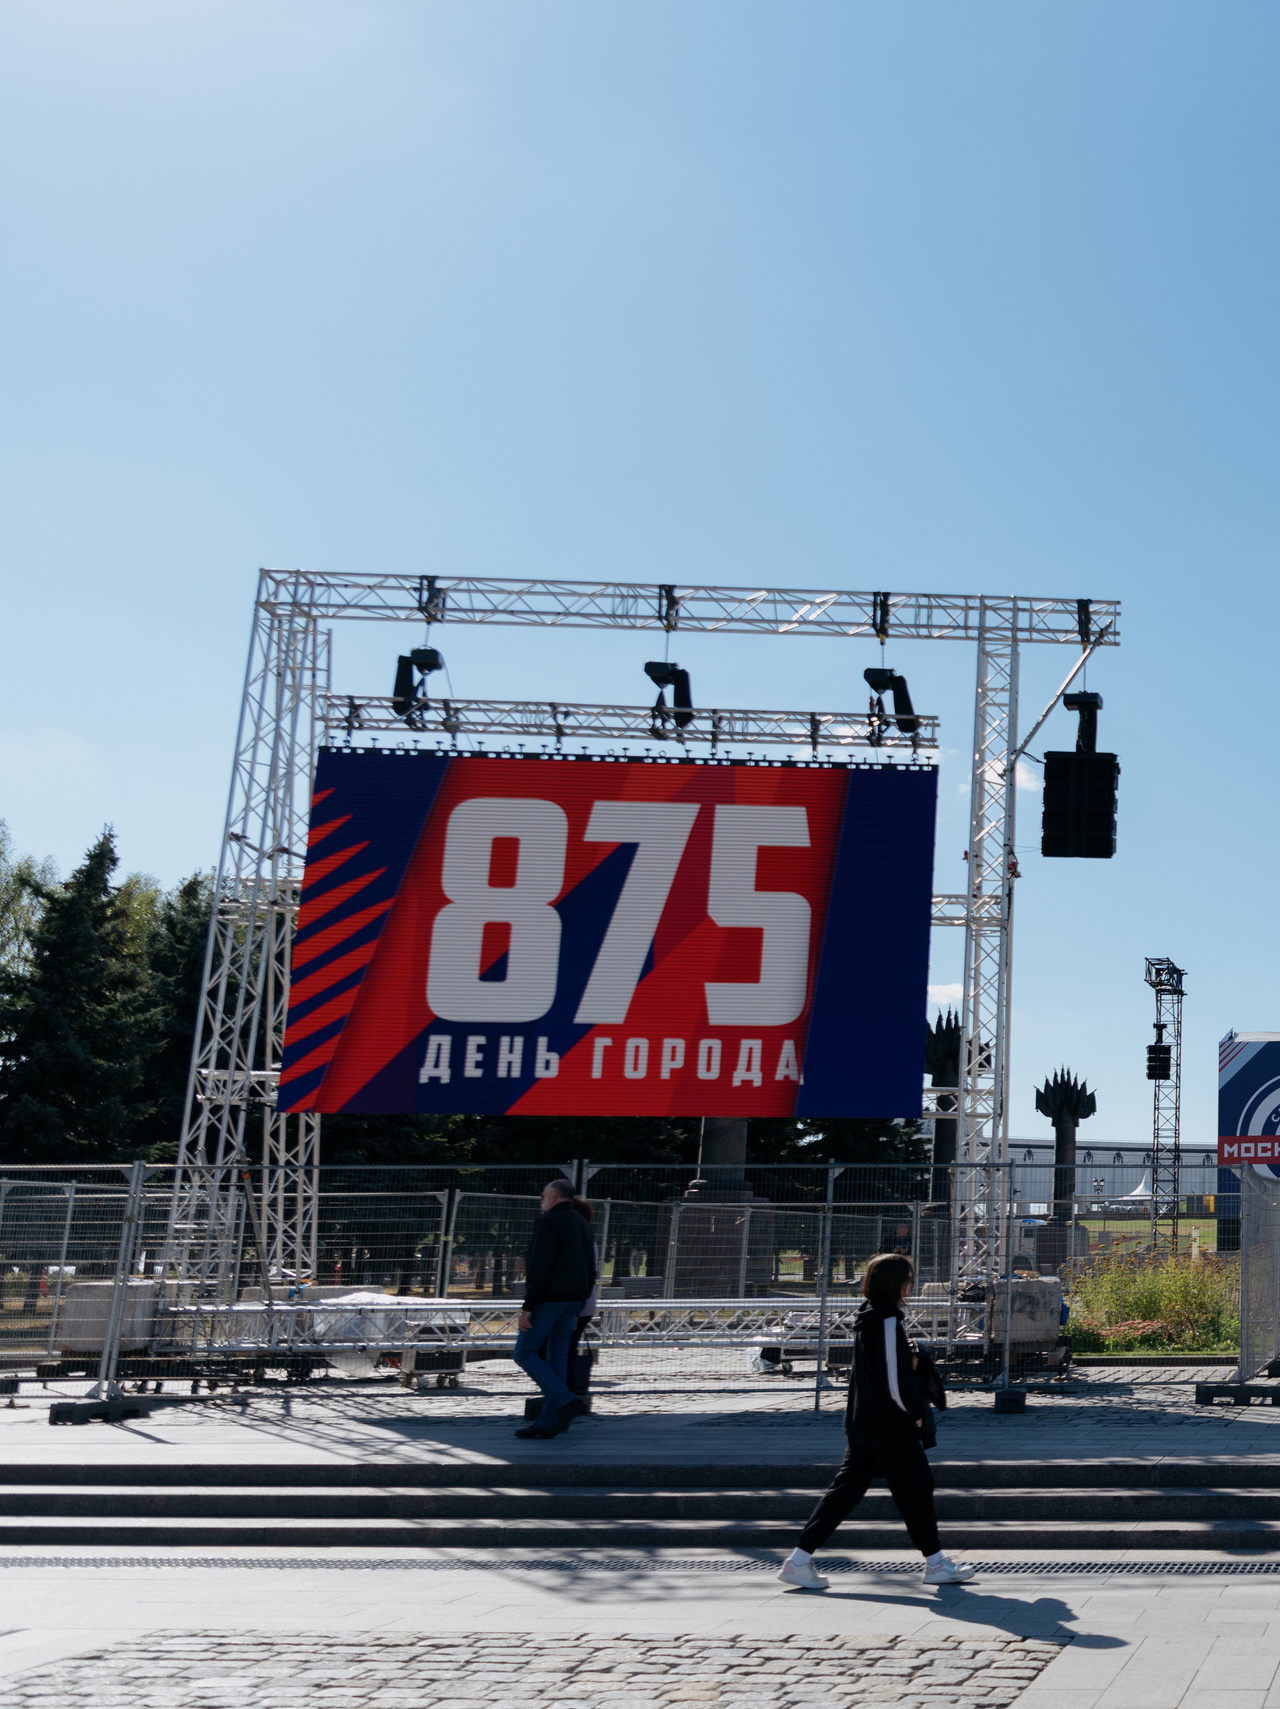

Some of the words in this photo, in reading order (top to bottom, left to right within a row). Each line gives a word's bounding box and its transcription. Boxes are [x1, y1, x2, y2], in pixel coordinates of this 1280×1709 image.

[426, 798, 812, 1026] 875
[419, 1035, 560, 1085] ДЕНЬ
[591, 1037, 805, 1088] ГОРОДА
[1271, 1113, 1280, 1123] С
